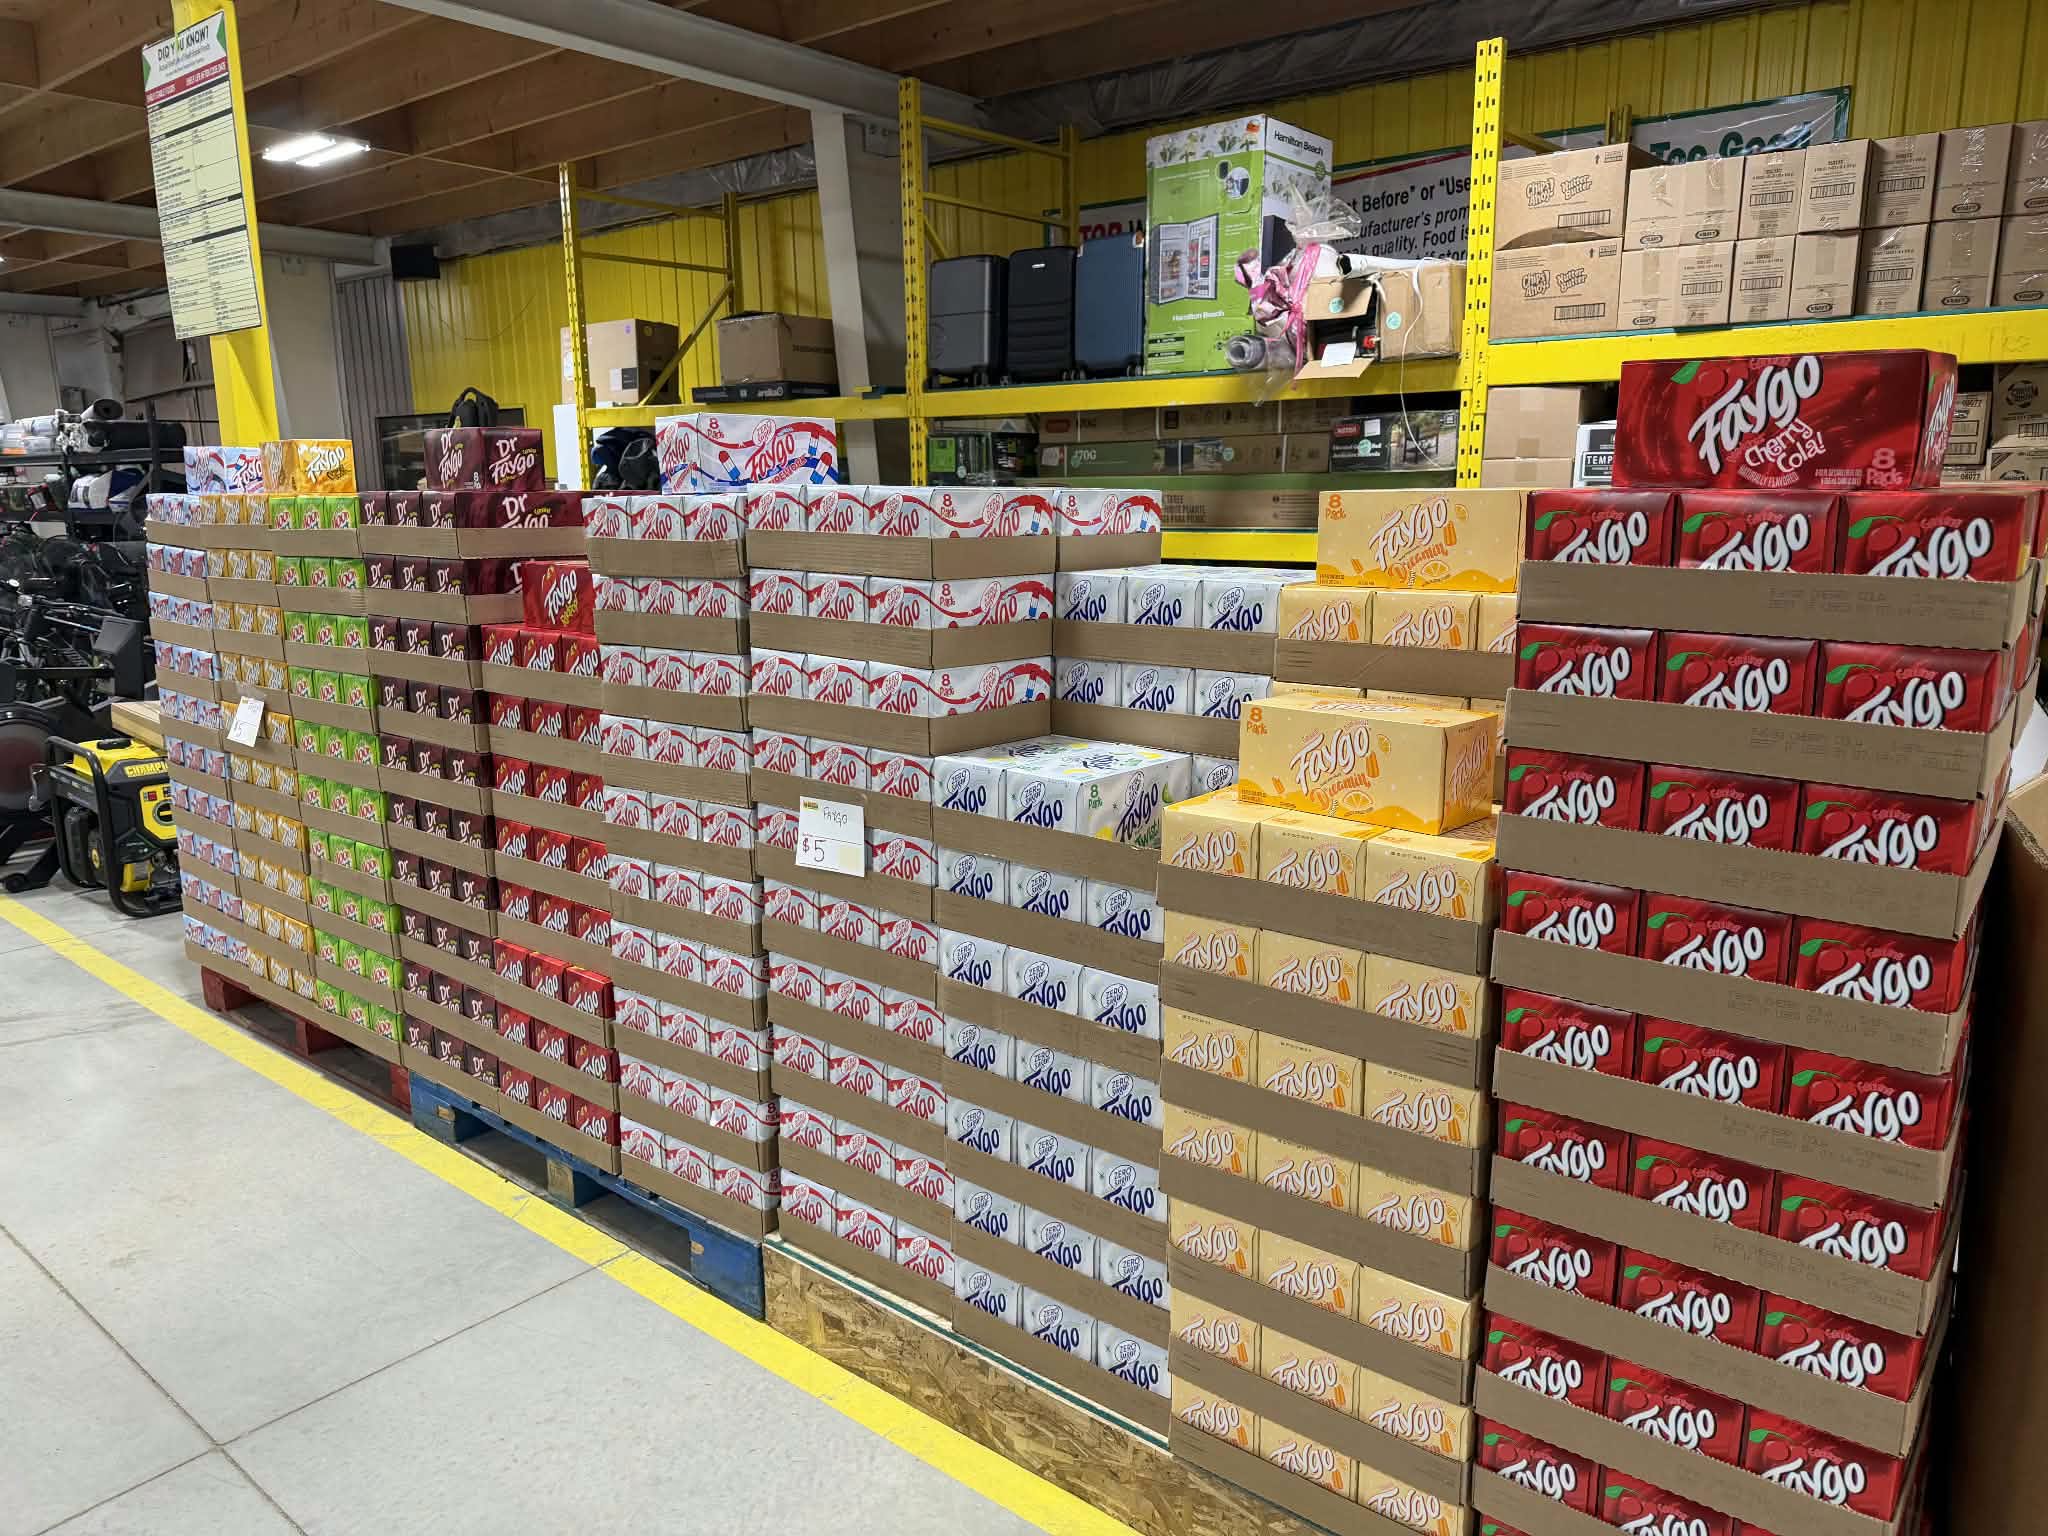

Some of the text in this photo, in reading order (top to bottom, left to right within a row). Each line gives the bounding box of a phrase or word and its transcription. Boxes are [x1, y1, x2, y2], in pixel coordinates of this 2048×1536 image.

[158, 45, 169, 61] DID
[185, 26, 208, 47] KNOW?
[1274, 130, 1323, 156] Hamilton Beach
[1421, 184, 1435, 200] or
[1423, 227, 1456, 247] Food
[710, 418, 719, 429] 8
[1688, 355, 1823, 475] Faygo
[441, 431, 452, 456] Dr
[708, 429, 724, 439] Pack
[1745, 418, 1813, 467] Cherry
[496, 437, 518, 457] Dr
[1777, 431, 1826, 473] Cola!
[307, 447, 346, 482] Faygo
[745, 432, 795, 483] Faygo
[1872, 448, 1896, 469] 8
[439, 449, 462, 488] Faygo
[489, 453, 538, 484] Faygo
[502, 494, 527, 516] Dr
[943, 494, 952, 507] 8
[1069, 496, 1075, 507] 8
[1329, 494, 1341, 508] 8
[1325, 508, 1346, 520] Pack
[1369, 498, 1448, 572] Faygo
[371, 563, 382, 581] Dr
[403, 565, 414, 584] Dr
[437, 568, 449, 586] Dr
[544, 570, 577, 625] Faygo
[942, 583, 951, 597] 8
[375, 625, 385, 643] Dr
[407, 628, 418, 647] Dr
[442, 632, 453, 651] Dr
[942, 673, 951, 686] 8
[1250, 707, 1262, 722] 8
[1247, 721, 1268, 735] Pack
[1290, 725, 1370, 796] Faygo
[1090, 784, 1099, 798] 8
[1115, 783, 1158, 843] Faygo
[802, 838, 827, 862] $ 5
